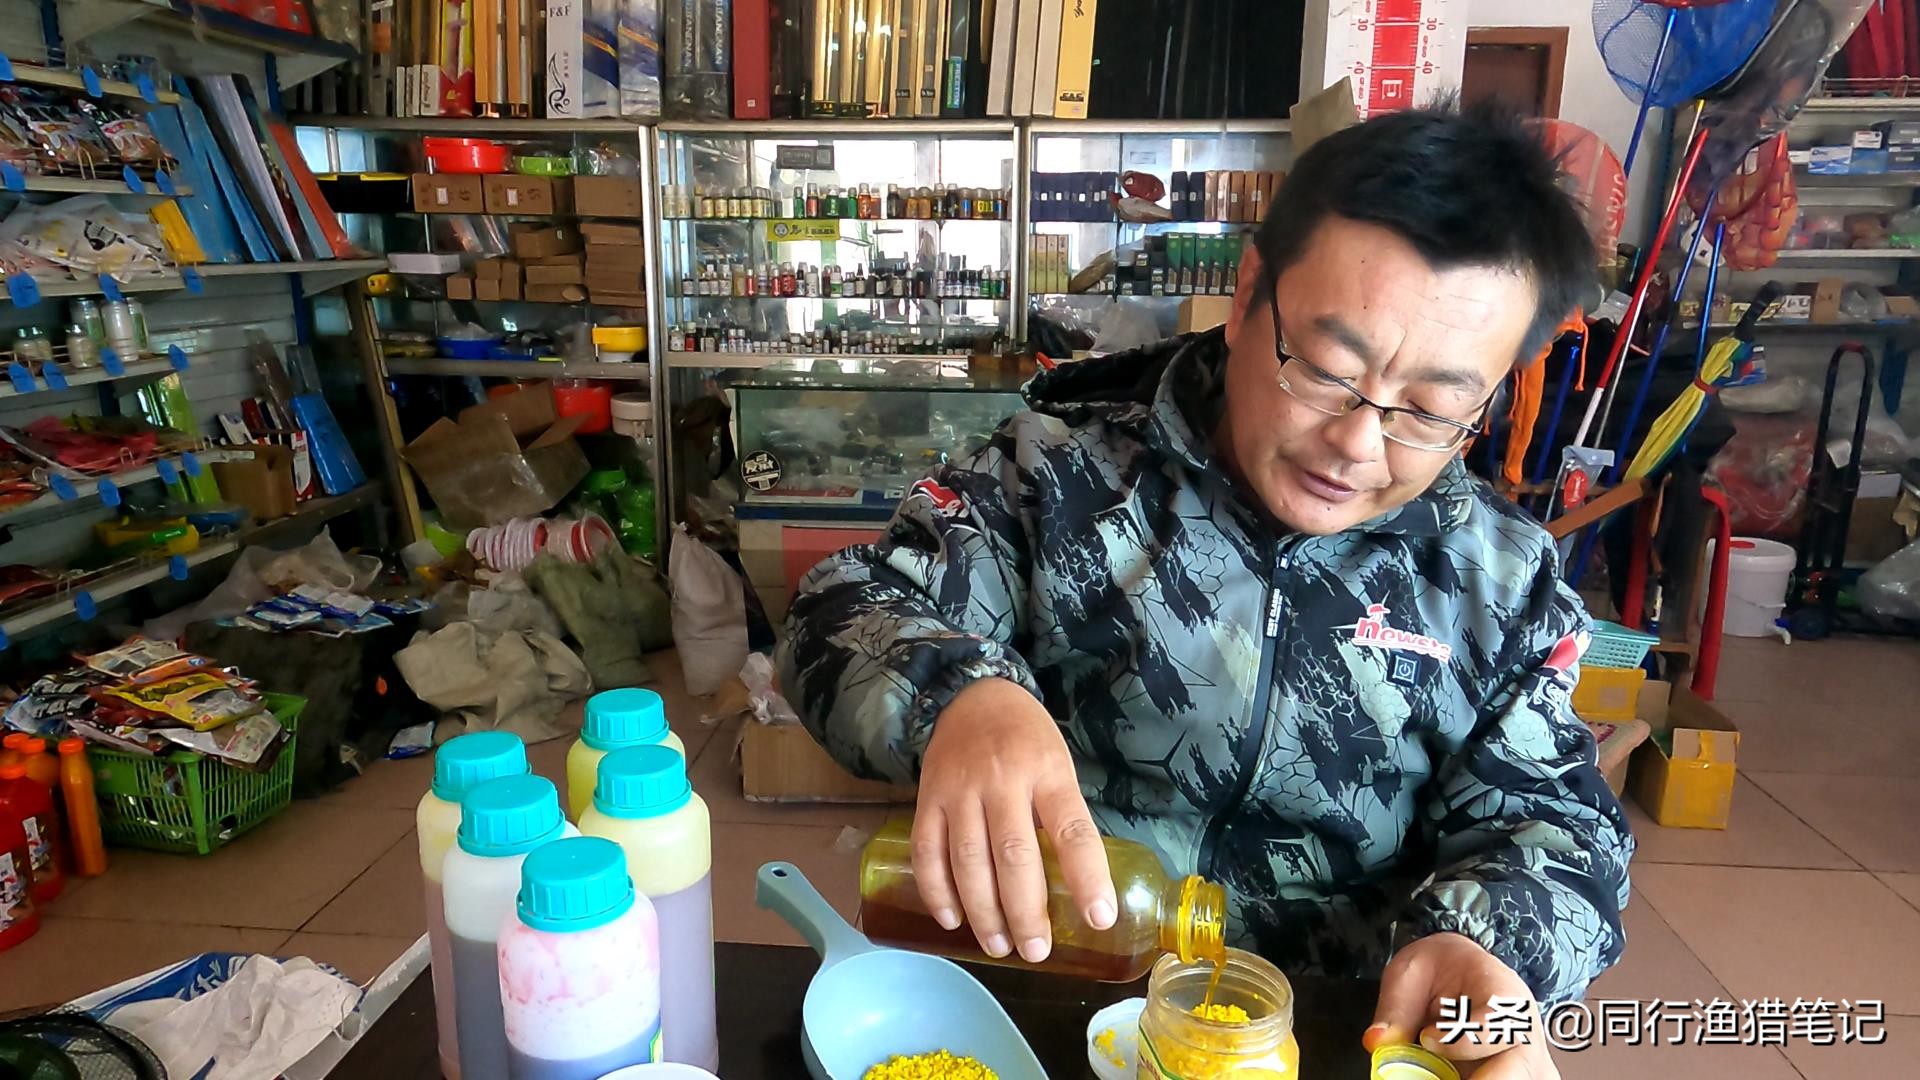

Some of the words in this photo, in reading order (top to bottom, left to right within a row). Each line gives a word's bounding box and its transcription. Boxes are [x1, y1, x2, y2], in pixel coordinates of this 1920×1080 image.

[1357, 18, 1368, 31] 30
[1426, 17, 1437, 31] 30
[1422, 61, 1433, 75] 40
